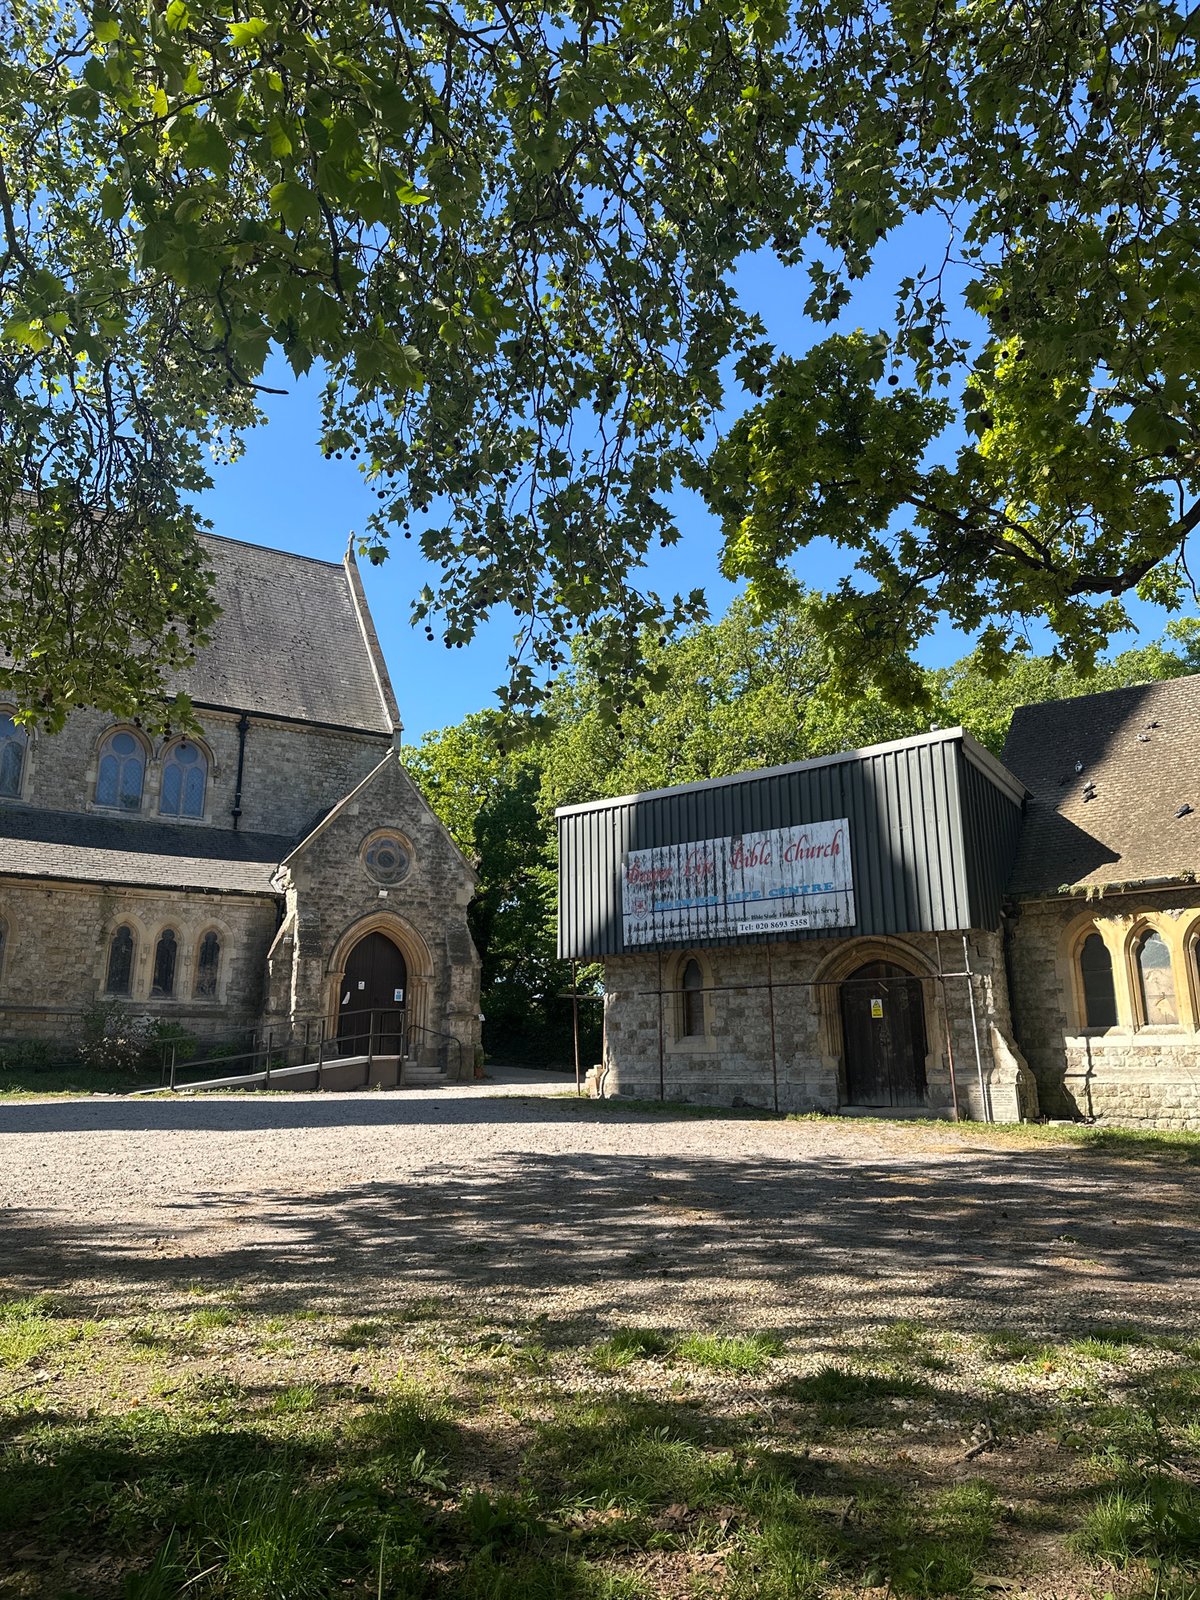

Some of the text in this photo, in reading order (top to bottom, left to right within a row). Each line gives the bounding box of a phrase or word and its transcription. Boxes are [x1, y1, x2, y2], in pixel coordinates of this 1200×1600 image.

[684, 847, 714, 884] Life
[729, 840, 772, 870] Bible
[784, 829, 845, 863] Church
[726, 890, 762, 902] LIFE
[768, 882, 834, 896] CENTRE
[755, 922, 769, 930] 020
[770, 920, 788, 928] 8693
[790, 918, 808, 926] 5358
